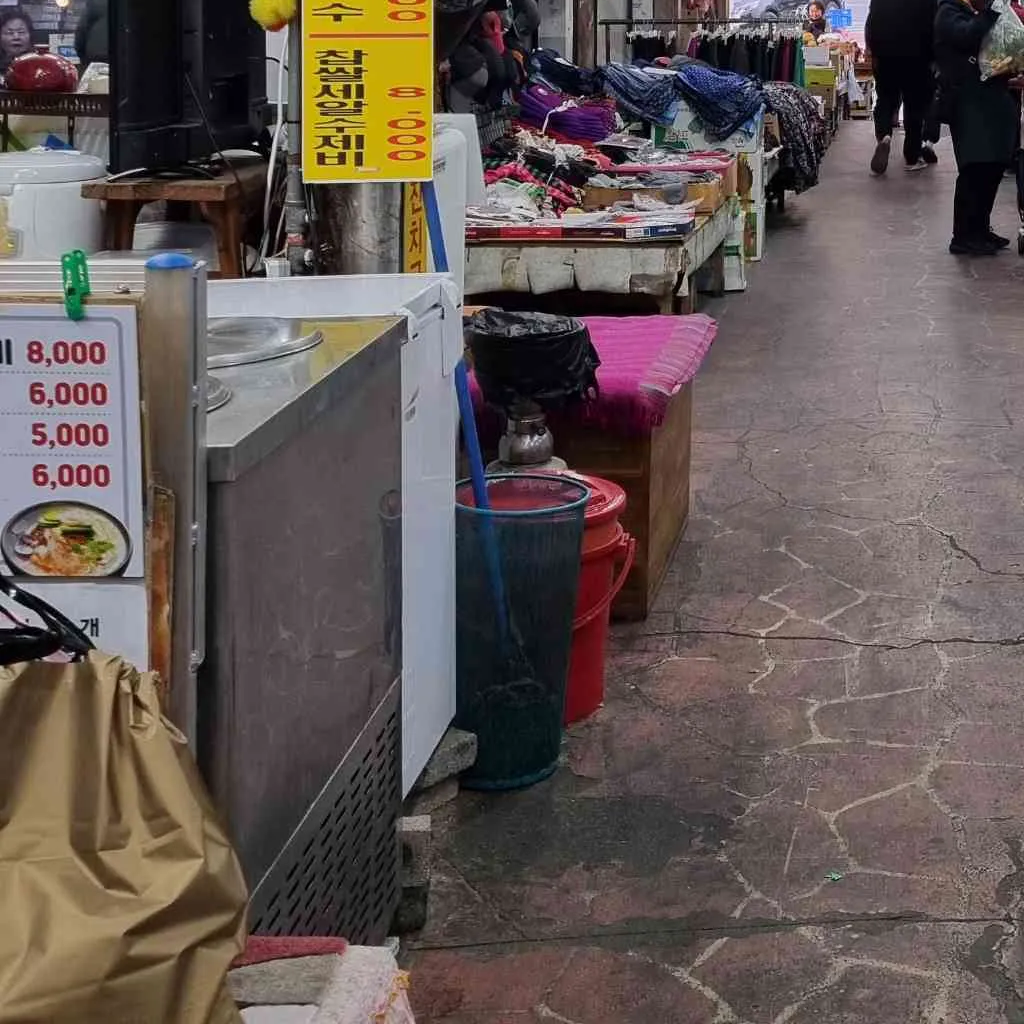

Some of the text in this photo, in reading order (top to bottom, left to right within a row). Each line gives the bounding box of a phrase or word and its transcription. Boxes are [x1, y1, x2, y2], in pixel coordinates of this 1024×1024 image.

[26, 340, 107, 368] 8,000
[29, 381, 108, 408] 6,000
[31, 422, 110, 450] 5,000
[32, 463, 111, 490] 6,000
